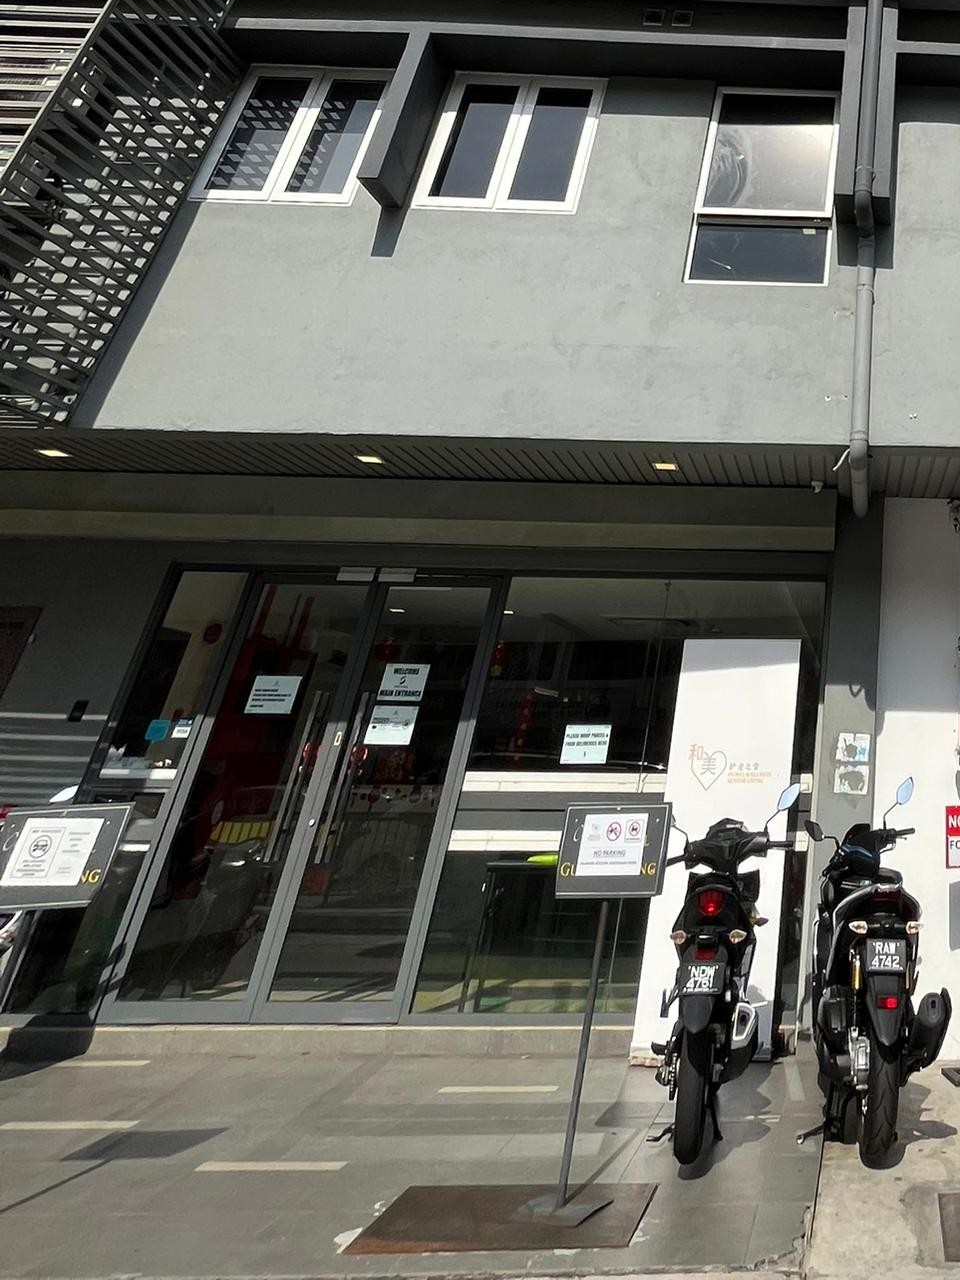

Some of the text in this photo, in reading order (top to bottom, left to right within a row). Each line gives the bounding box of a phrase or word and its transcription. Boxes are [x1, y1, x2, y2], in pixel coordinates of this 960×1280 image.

[875, 941, 896, 955] RAW
[871, 955, 900, 968] 4742
[685, 976, 714, 989] 4761
